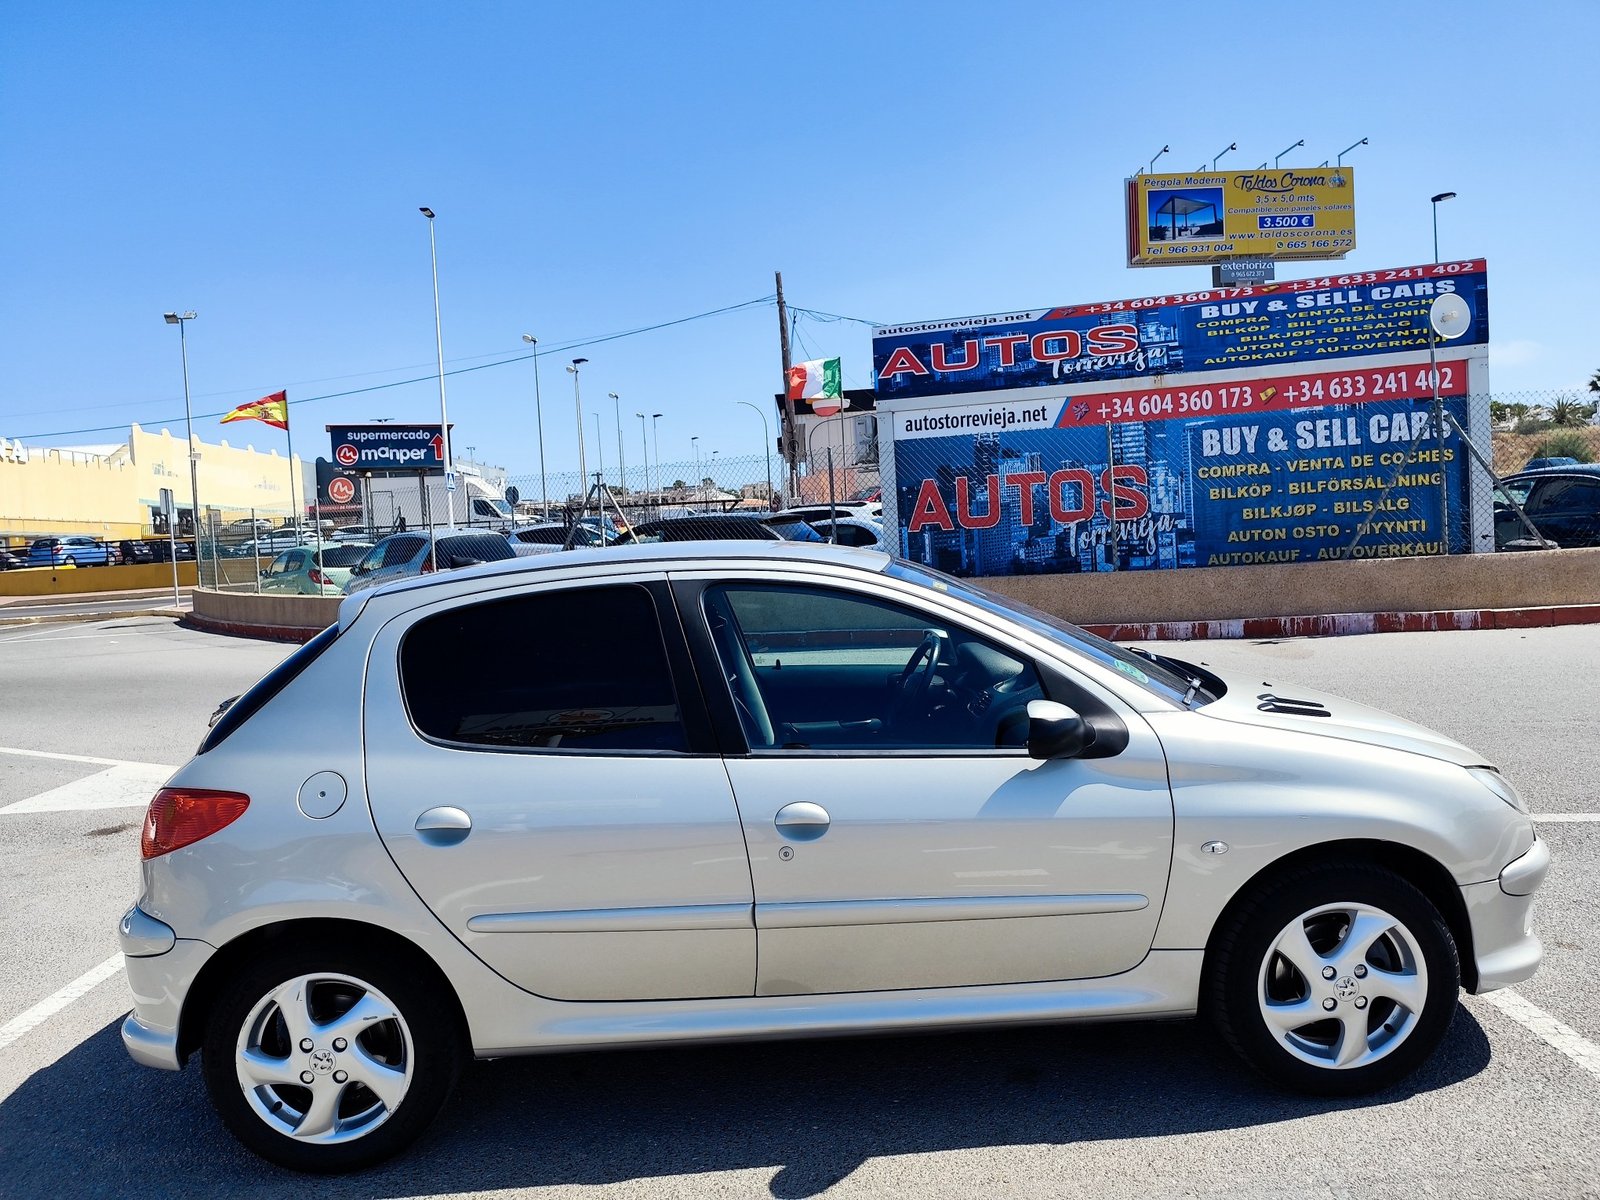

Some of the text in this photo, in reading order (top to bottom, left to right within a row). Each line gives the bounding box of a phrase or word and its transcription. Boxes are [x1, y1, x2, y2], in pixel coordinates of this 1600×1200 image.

[1185, 176, 1227, 185] Moderna
[1234, 172, 1326, 193] Toldos Corona
[1228, 206, 1272, 214] Compatible
[1291, 204, 1321, 212] paneles
[1263, 215, 1310, 228] 3.500 €
[1229, 229, 1353, 240] www.toldoscorona.es
[1287, 238, 1352, 249] 665 166 572
[1168, 245, 1188, 254] 966
[1191, 244, 1210, 253] 931
[1213, 243, 1234, 252] 004
[1221, 260, 1274, 271] exterioriza
[1288, 262, 1474, 290] +34 633 241 402
[1085, 286, 1254, 313] +34 604 360 173
[1201, 279, 1456, 319] BUY & SELL CARS
[878, 312, 1032, 336] autostorrevieja.net
[1196, 315, 1270, 329] COMPRA
[1286, 308, 1345, 319] VENTA
[1351, 304, 1375, 312] DE
[1381, 297, 1435, 309] COCH
[1207, 325, 1271, 337] BILKÖP
[1287, 308, 1429, 329] BILFÖRSÄLJNIN
[1225, 342, 1285, 354] AUTON
[1291, 336, 1339, 346] OSTO
[1356, 327, 1429, 341] MYYNTI
[1240, 329, 1316, 343] BILKJØP
[1333, 320, 1412, 334] BILSALG
[878, 325, 1139, 380] AUTOS
[1047, 346, 1167, 380] Torrevieja
[1204, 350, 1298, 365] AUTOKAUF
[1283, 367, 1453, 403] +34 633 241 402
[1097, 386, 1253, 419] +34 604 360 173
[905, 405, 1047, 433] autostorrevieja.net
[347, 429, 430, 442] supermercado
[1202, 409, 1452, 457] BUY & SELL CARS
[361, 446, 427, 464] manper
[1198, 462, 1271, 479] COMPRA
[1286, 456, 1345, 472] VENTA
[1351, 454, 1374, 468] DE
[1380, 448, 1454, 466] COCHES
[908, 464, 1149, 533] AUTOS
[1209, 482, 1272, 500] BILKÖP
[1242, 503, 1317, 520] BILKJØP
[1333, 497, 1410, 514] BILSALG
[1067, 512, 1176, 558] Torrevieja
[1227, 528, 1287, 543] AUTON
[1292, 524, 1340, 540] OSTO
[1356, 519, 1427, 535] MYYNTI
[1207, 549, 1300, 566] AUTOKAUF
